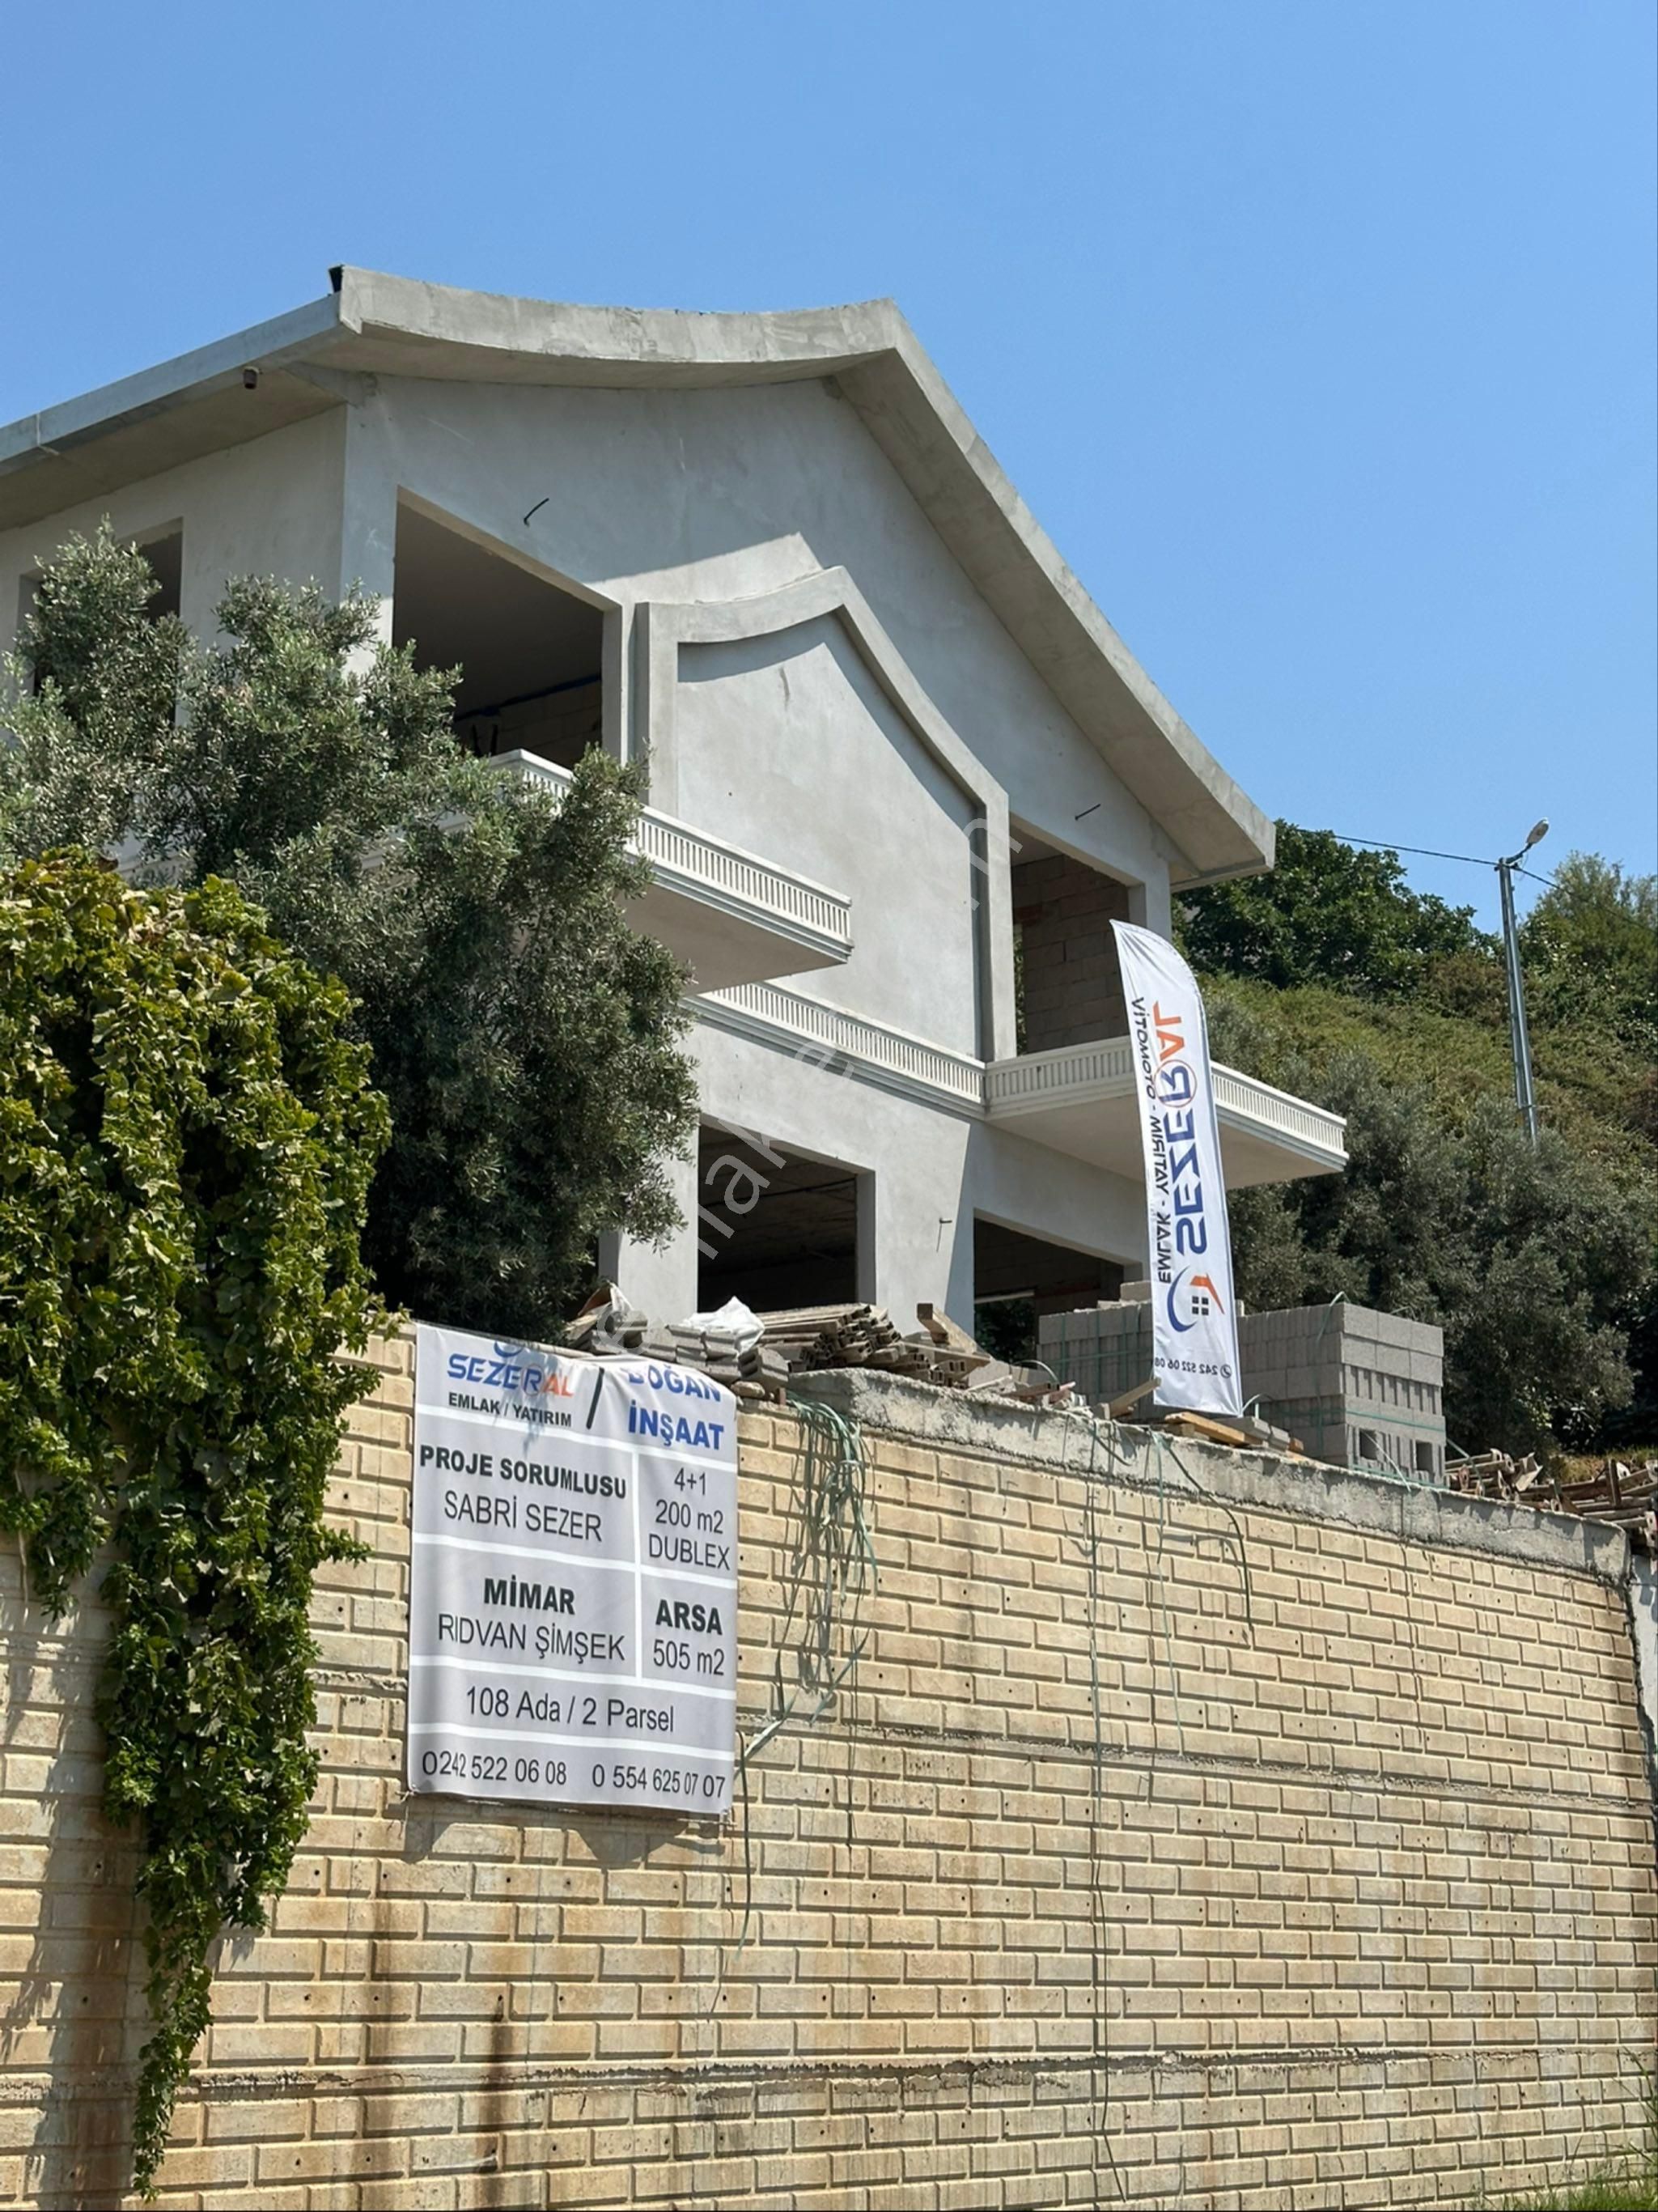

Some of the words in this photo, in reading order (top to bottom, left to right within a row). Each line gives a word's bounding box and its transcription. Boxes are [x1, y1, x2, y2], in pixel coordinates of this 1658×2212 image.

[447, 1353, 574, 1397] SEZERAL
[448, 1391, 500, 1415] EMLAK
[513, 1404, 571, 1428] YATIRIM
[629, 1399, 724, 1450] İNŞAAT
[420, 1445, 493, 1477] PROJE
[500, 1458, 626, 1498] SORUMLUSU
[675, 1467, 706, 1496] 4+1
[444, 1490, 517, 1528] SABRİ
[526, 1504, 602, 1542] SEZER
[655, 1499, 691, 1527] 200
[698, 1509, 723, 1534] m2
[649, 1534, 730, 1570] DUBLEX
[484, 1575, 575, 1615] MİMAR
[655, 1599, 723, 1635] ARSA
[439, 1614, 526, 1649] RIDVAN
[535, 1623, 625, 1663] ŞİMŞEK
[654, 1640, 690, 1669] 505
[698, 1648, 724, 1675] m2
[467, 1686, 509, 1717] 108
[516, 1691, 560, 1722] Ada
[567, 1696, 575, 1724] /
[583, 1698, 596, 1725] 2
[608, 1700, 674, 1732] Parsel
[471, 1756, 507, 1781] 522
[515, 1759, 539, 1782] 06
[545, 1761, 566, 1785] 08
[592, 1764, 605, 1787] 0
[613, 1765, 647, 1790] 554
[653, 1768, 680, 1794] 625
[684, 1773, 698, 1795] 07
[702, 1775, 725, 1798] 07
